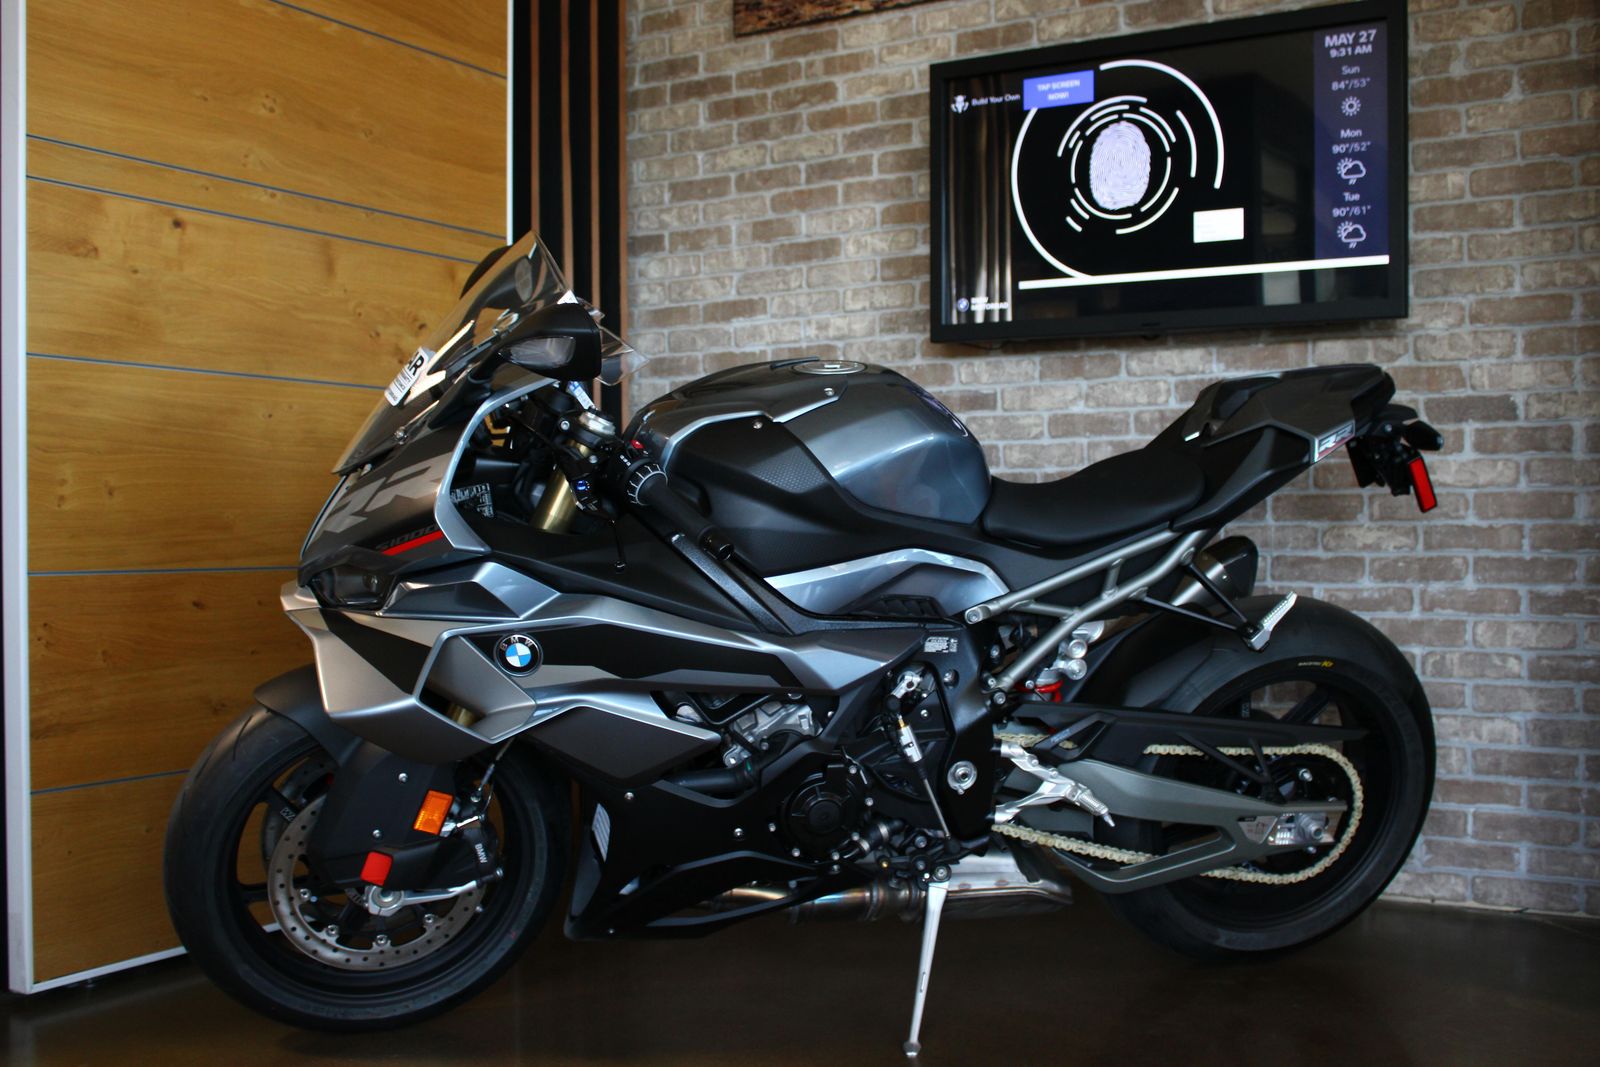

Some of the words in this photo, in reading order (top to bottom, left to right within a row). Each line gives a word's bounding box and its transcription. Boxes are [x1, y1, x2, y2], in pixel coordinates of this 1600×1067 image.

[1325, 32, 1356, 47] MAY
[1359, 29, 1376, 43] 27
[1354, 44, 1372, 55] AM
[1342, 65, 1360, 75] Sun
[1037, 83, 1051, 91] TAP
[1052, 80, 1080, 90] SCREEN
[971, 97, 988, 106] Build
[990, 95, 1003, 104] Your
[1004, 94, 1020, 102] Own
[1340, 129, 1362, 139] Mon
[1343, 192, 1360, 202] Tue
[500, 634, 535, 651] BMW
[475, 843, 488, 863] BMW
